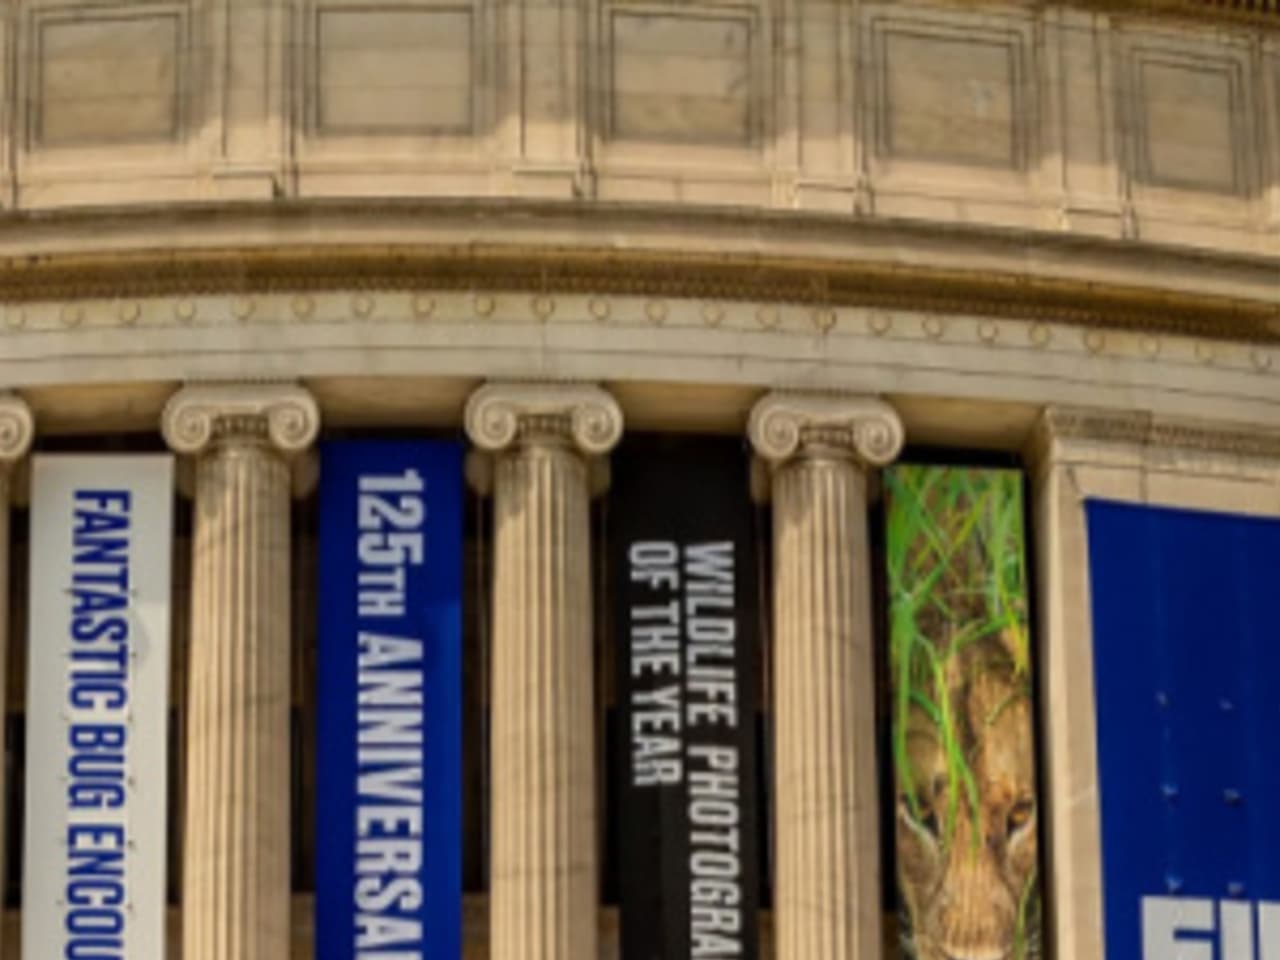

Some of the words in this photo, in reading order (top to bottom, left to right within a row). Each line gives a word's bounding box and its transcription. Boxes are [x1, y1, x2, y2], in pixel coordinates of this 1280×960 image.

[357, 469, 424, 616] 125TH
[629, 540, 679, 590] OF
[70, 489, 131, 710] FANTASTIC
[630, 600, 680, 676] THE
[685, 541, 737, 727] WILDLIFE
[68, 725, 126, 809] BUG
[631, 686, 683, 786] YEAR
